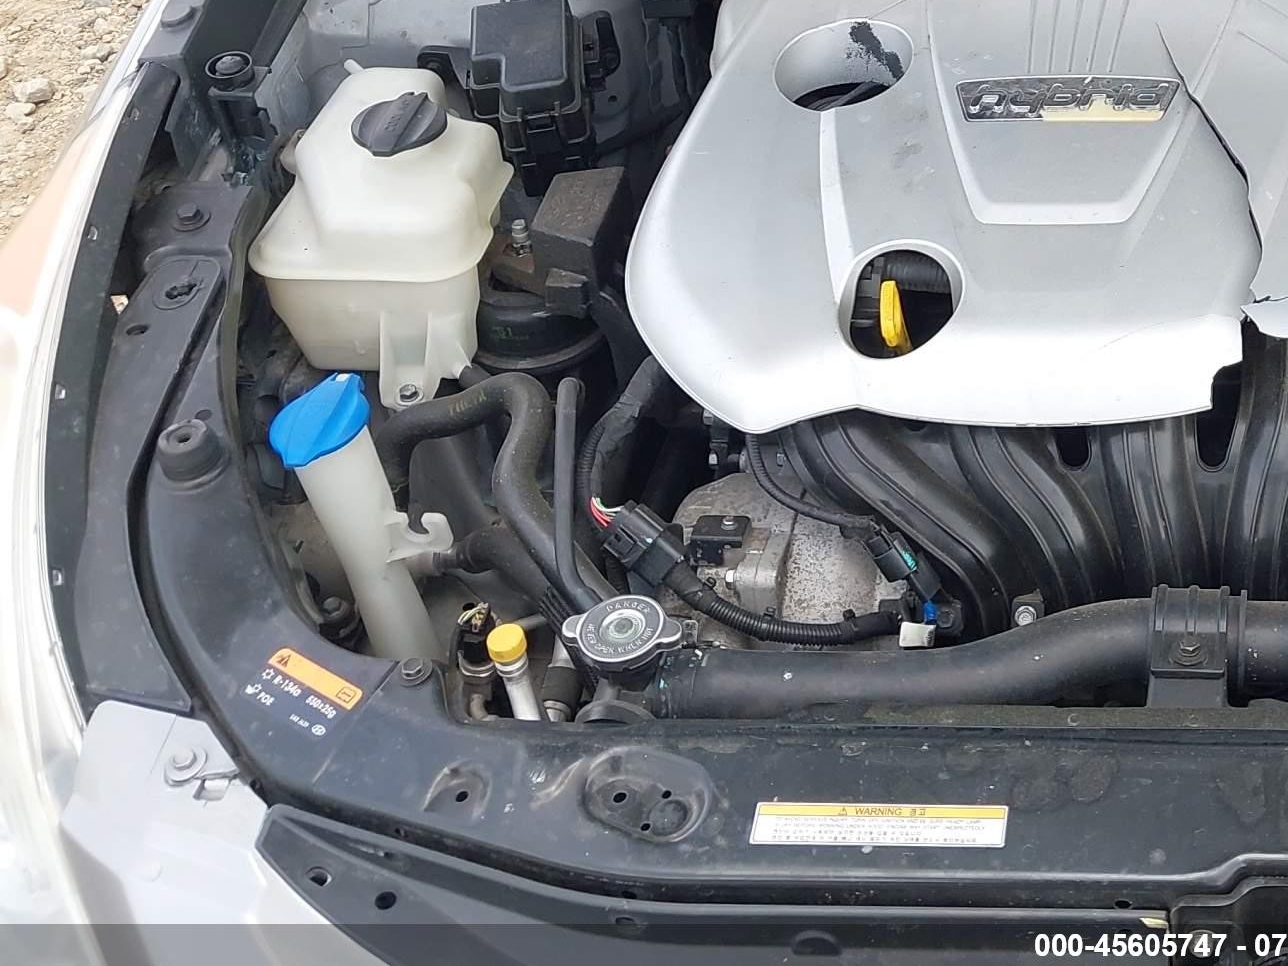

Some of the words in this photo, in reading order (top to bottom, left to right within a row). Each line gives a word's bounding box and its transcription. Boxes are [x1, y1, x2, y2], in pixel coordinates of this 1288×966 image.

[969, 83, 1168, 117] hybrid
[606, 601, 650, 614] DANGER
[855, 807, 902, 816] WARNING
